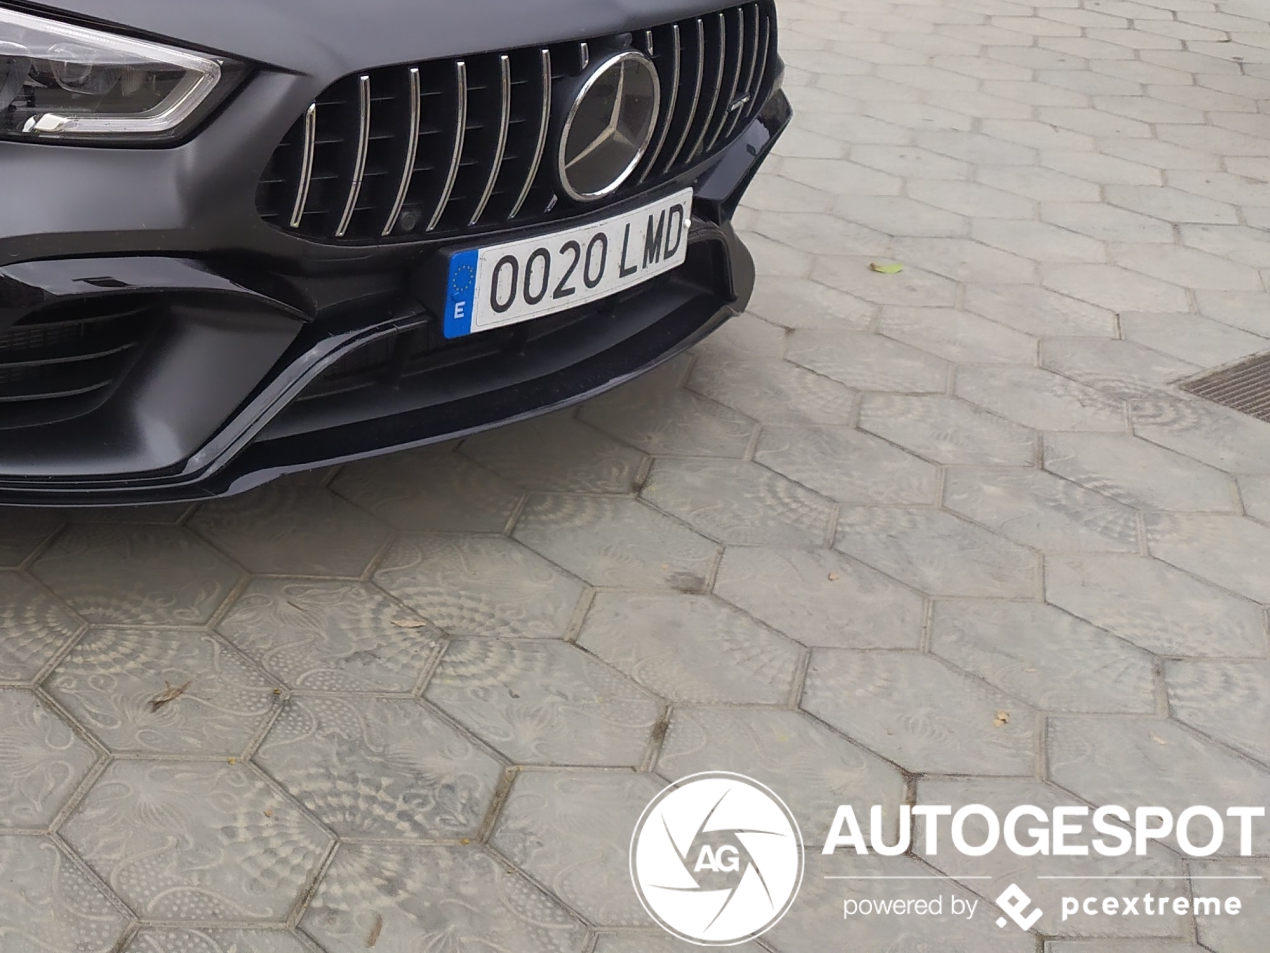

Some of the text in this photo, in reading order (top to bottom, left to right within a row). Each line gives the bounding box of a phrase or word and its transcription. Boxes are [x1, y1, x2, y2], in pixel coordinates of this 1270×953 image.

[490, 203, 683, 313] 0020 LMD
[453, 301, 465, 319] E
